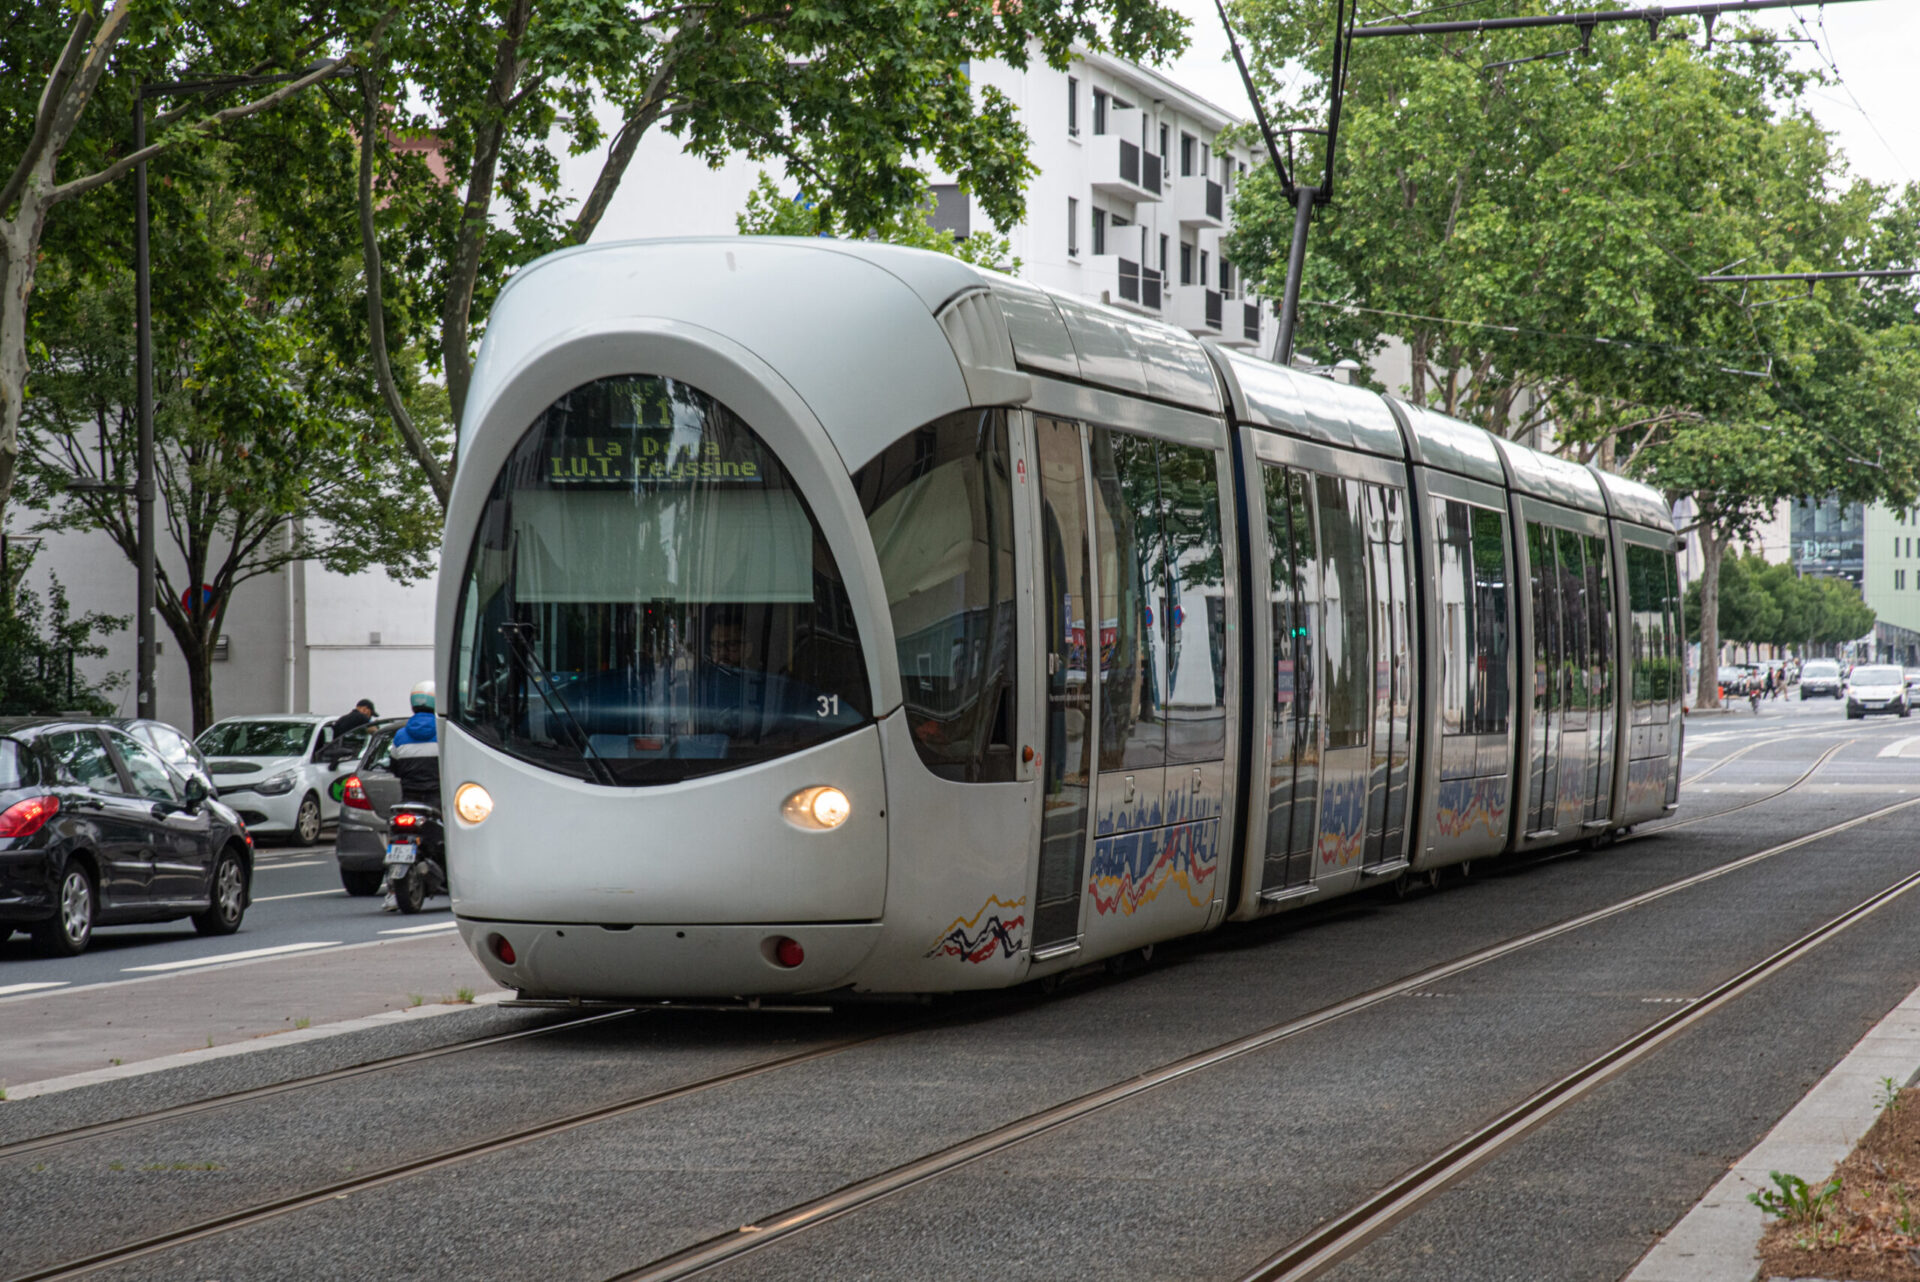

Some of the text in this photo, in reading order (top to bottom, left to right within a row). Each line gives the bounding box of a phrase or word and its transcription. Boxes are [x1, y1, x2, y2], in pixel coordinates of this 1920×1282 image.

[587, 437, 622, 457] La
[551, 456, 757, 479] I.U.T. Feyssine
[816, 694, 839, 717] 31
